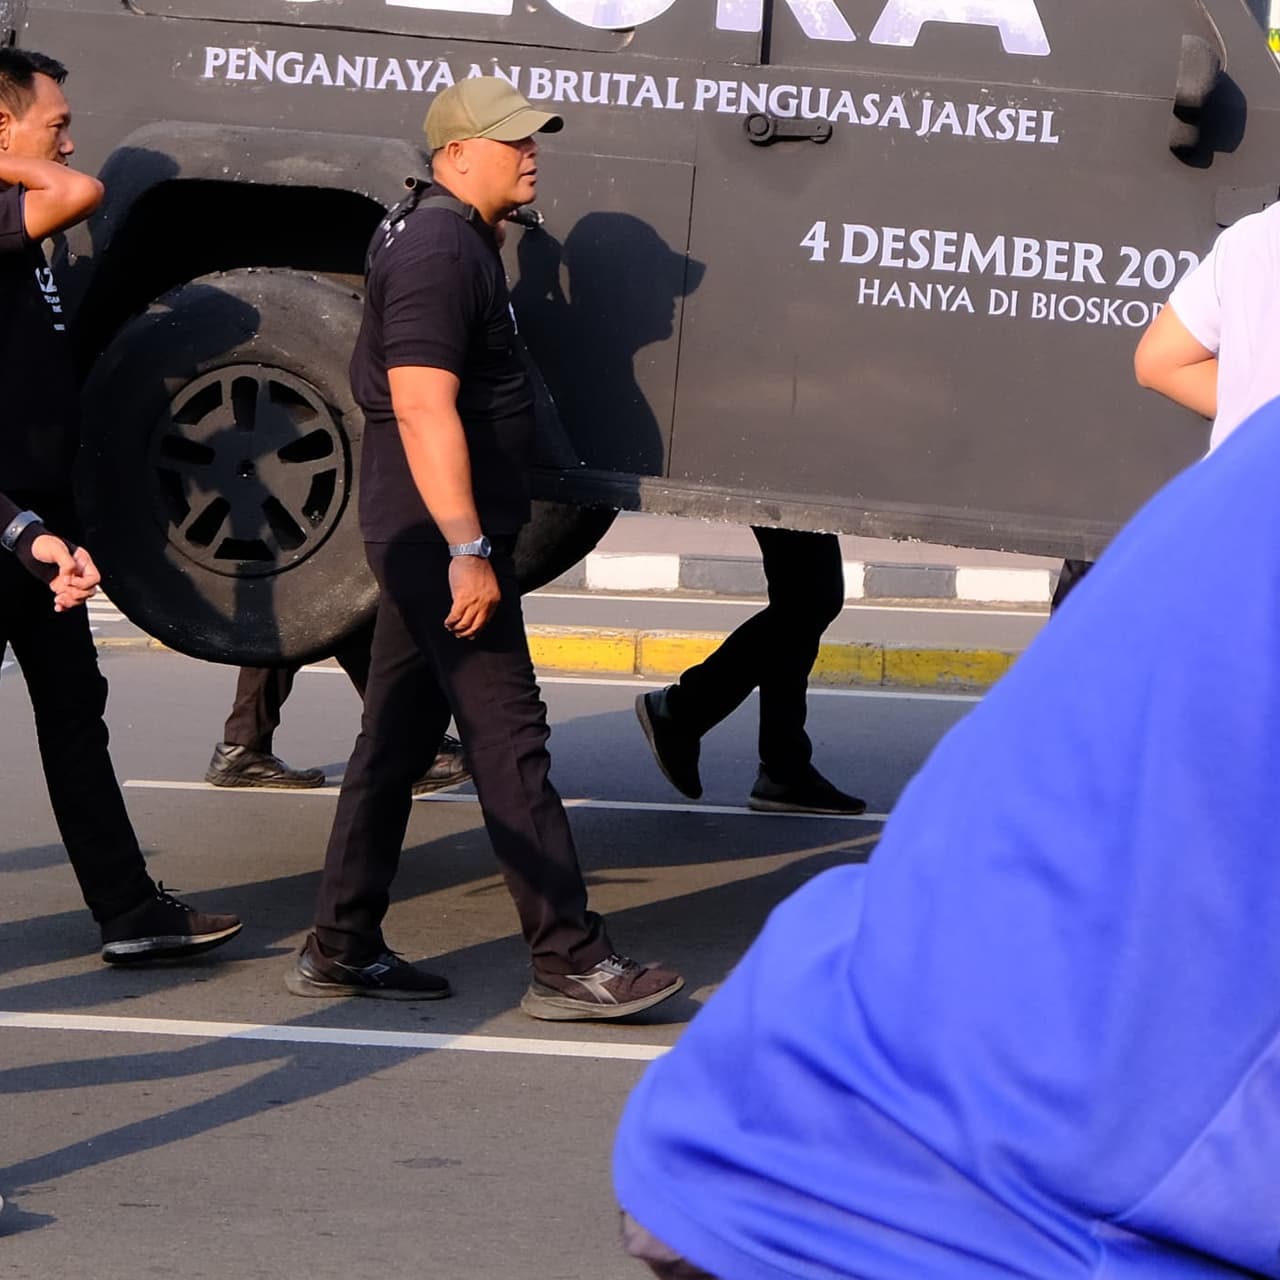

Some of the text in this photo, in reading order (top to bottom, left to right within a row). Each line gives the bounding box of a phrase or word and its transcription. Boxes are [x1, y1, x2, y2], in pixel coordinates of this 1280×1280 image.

[527, 66, 685, 111] BRUTAL
[693, 78, 911, 130] PENGUASA
[916, 99, 1060, 144] JAKSEL
[799, 220, 830, 262] 4
[839, 223, 1106, 285] DESEMBER
[856, 277, 976, 314] HANYA
[987, 288, 1018, 319] DI
